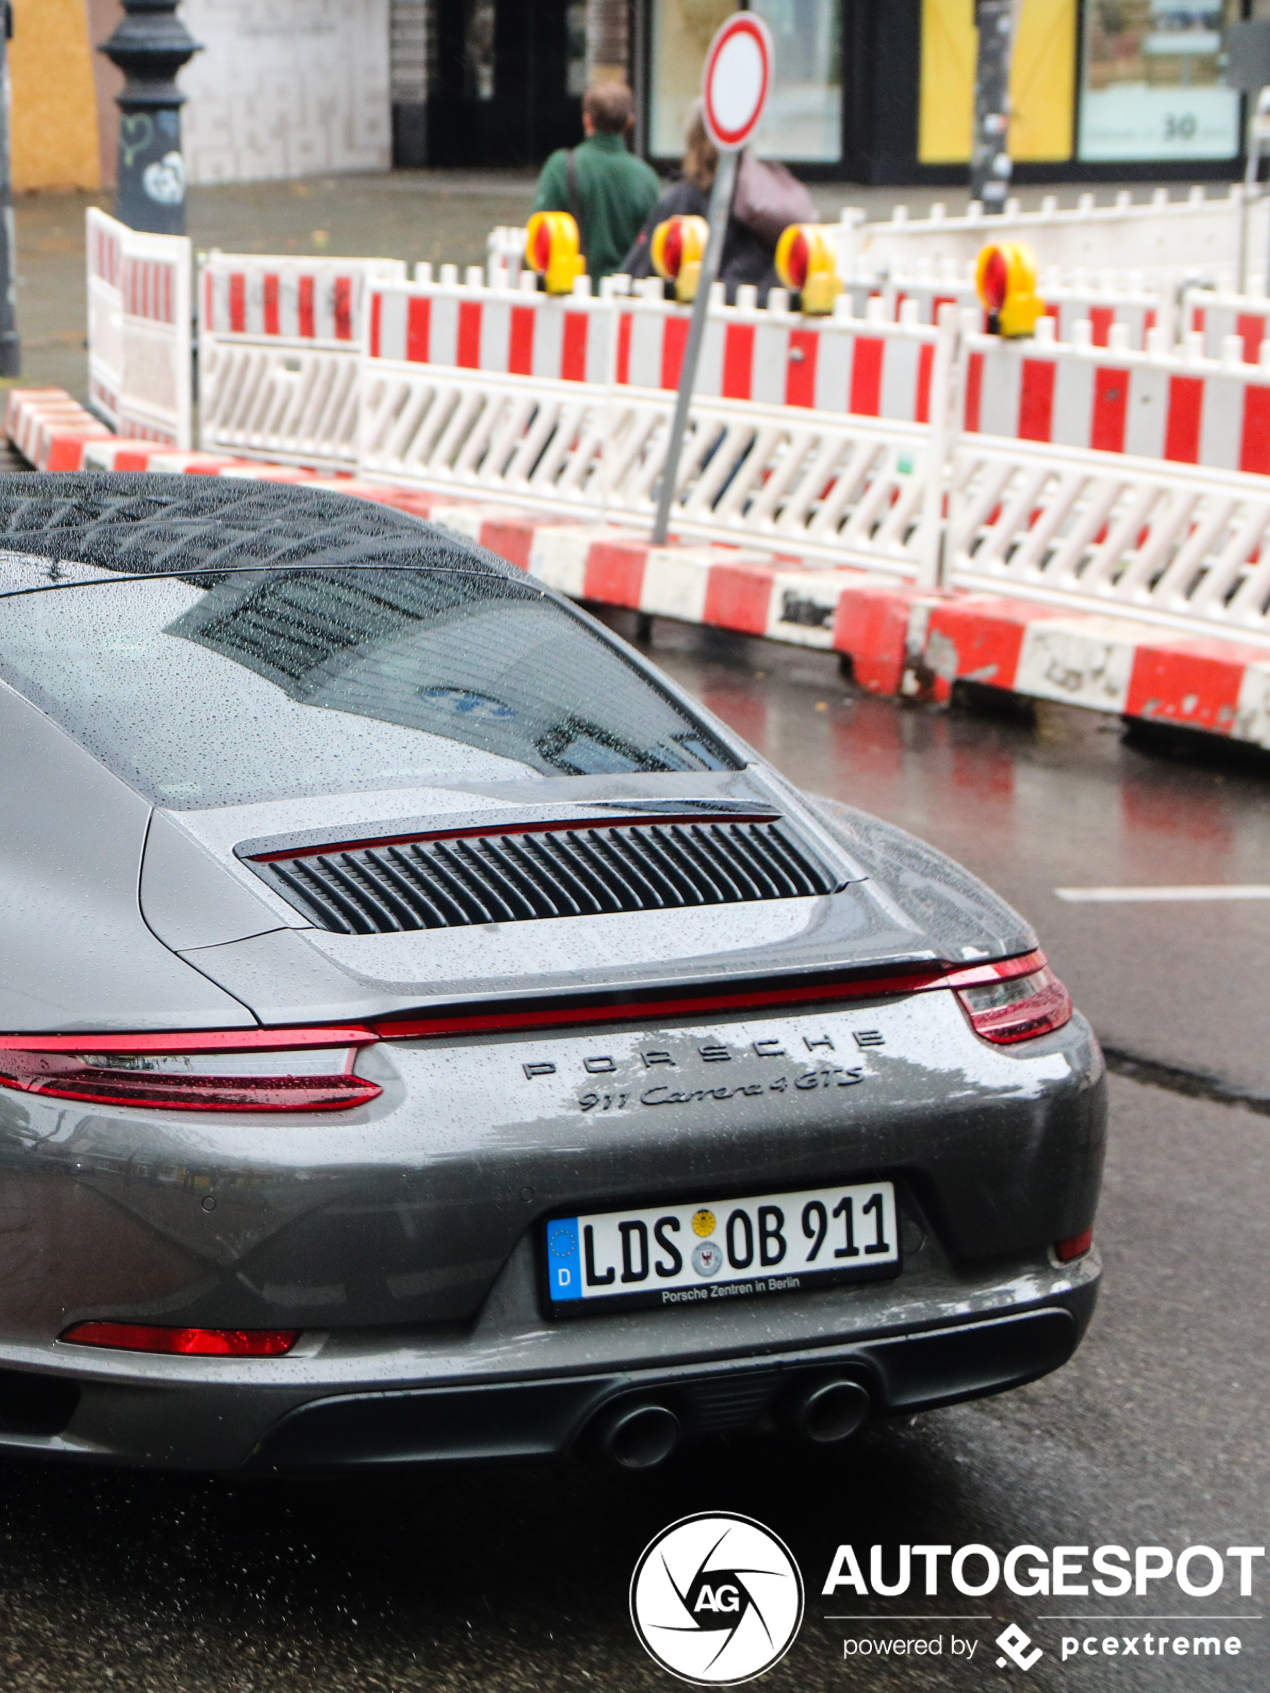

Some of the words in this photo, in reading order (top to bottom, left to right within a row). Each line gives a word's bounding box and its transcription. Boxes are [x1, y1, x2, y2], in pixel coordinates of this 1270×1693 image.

[522, 1029, 886, 1080] PORSCHE
[578, 1092, 631, 1112] 911
[640, 1085, 764, 1106] Carrera
[769, 1076, 788, 1094] 4
[794, 1066, 864, 1091] GTS
[582, 1215, 683, 1287] LDS
[726, 1205, 787, 1270] OB
[801, 1193, 891, 1262] 911
[558, 1268, 571, 1287] D
[662, 1287, 708, 1304] Porsche
[709, 1281, 753, 1299] Zentren
[755, 1279, 767, 1294] in
[769, 1276, 801, 1293] Berlin
